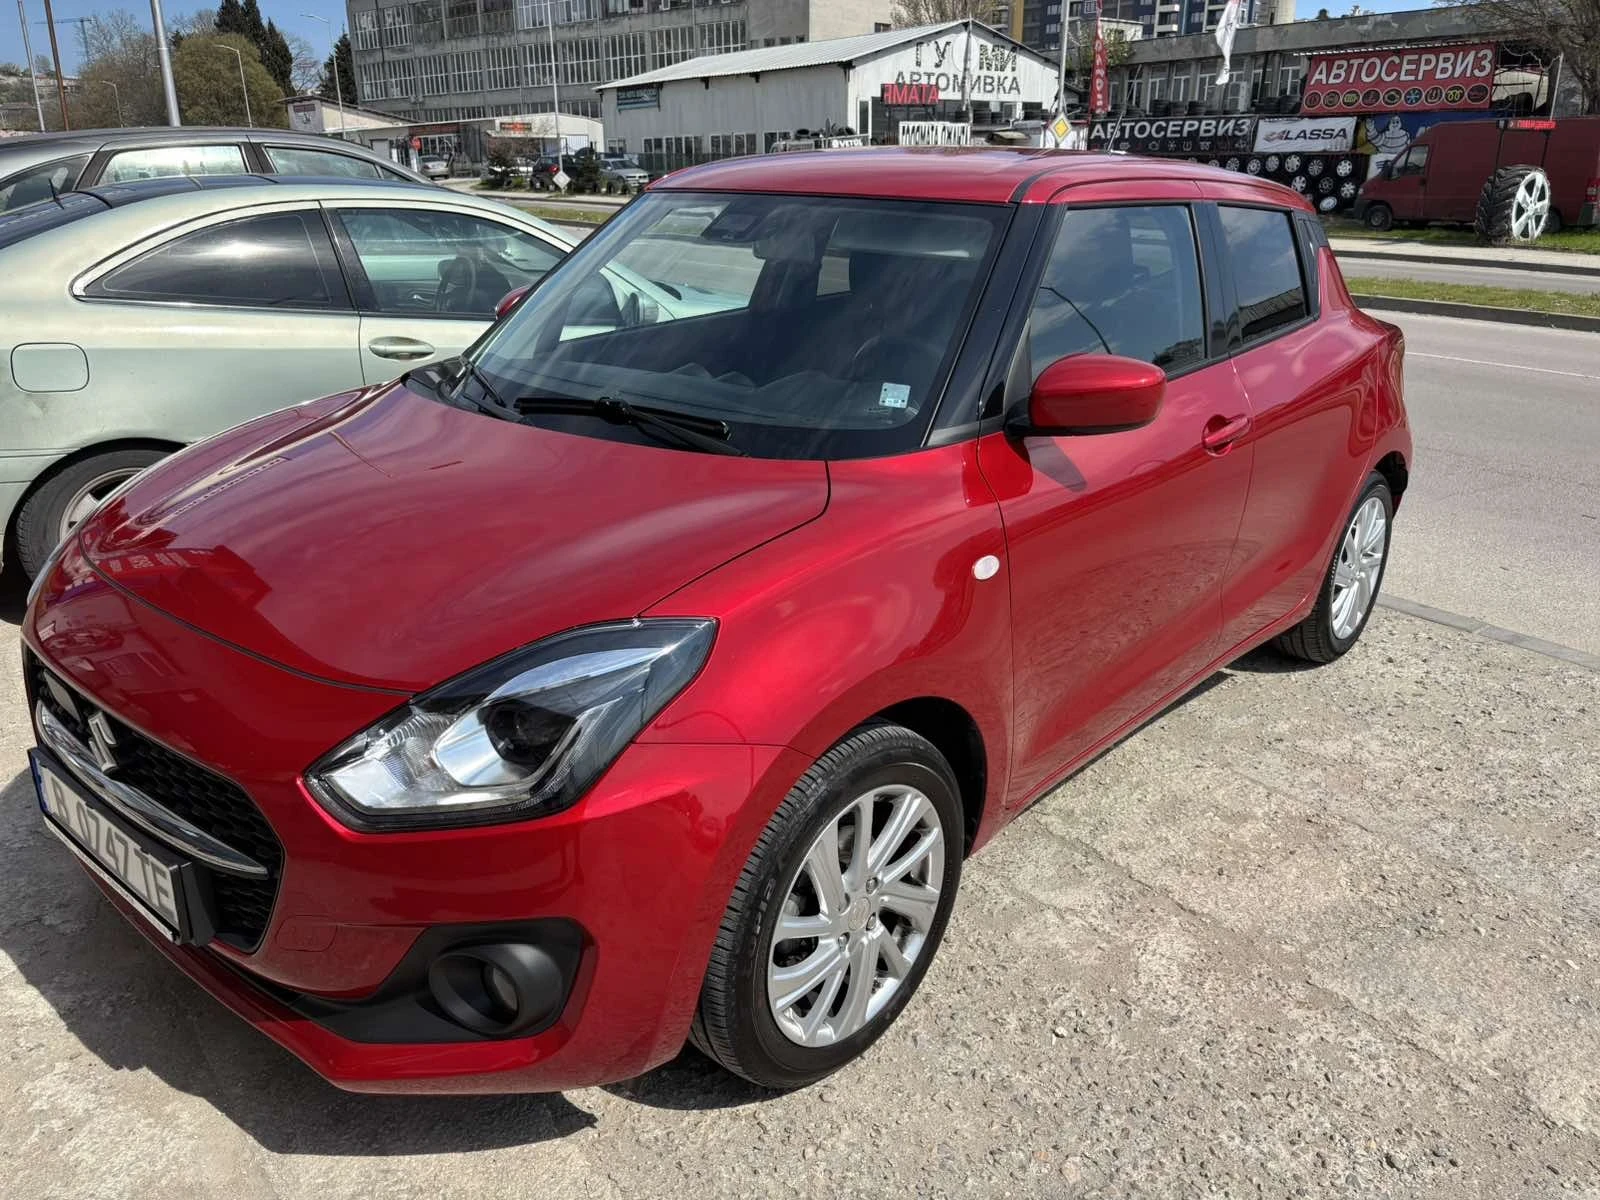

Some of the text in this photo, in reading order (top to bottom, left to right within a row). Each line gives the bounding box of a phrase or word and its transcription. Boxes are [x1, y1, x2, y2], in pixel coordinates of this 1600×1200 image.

[1310, 49, 1493, 85] АВТОСЕРВИЗ
[1090, 119, 1249, 139] АВТОСЕРВИЗ
[1284, 128, 1347, 141] LASSA
[76, 801, 129, 880] 0747
[134, 847, 175, 923] TE
